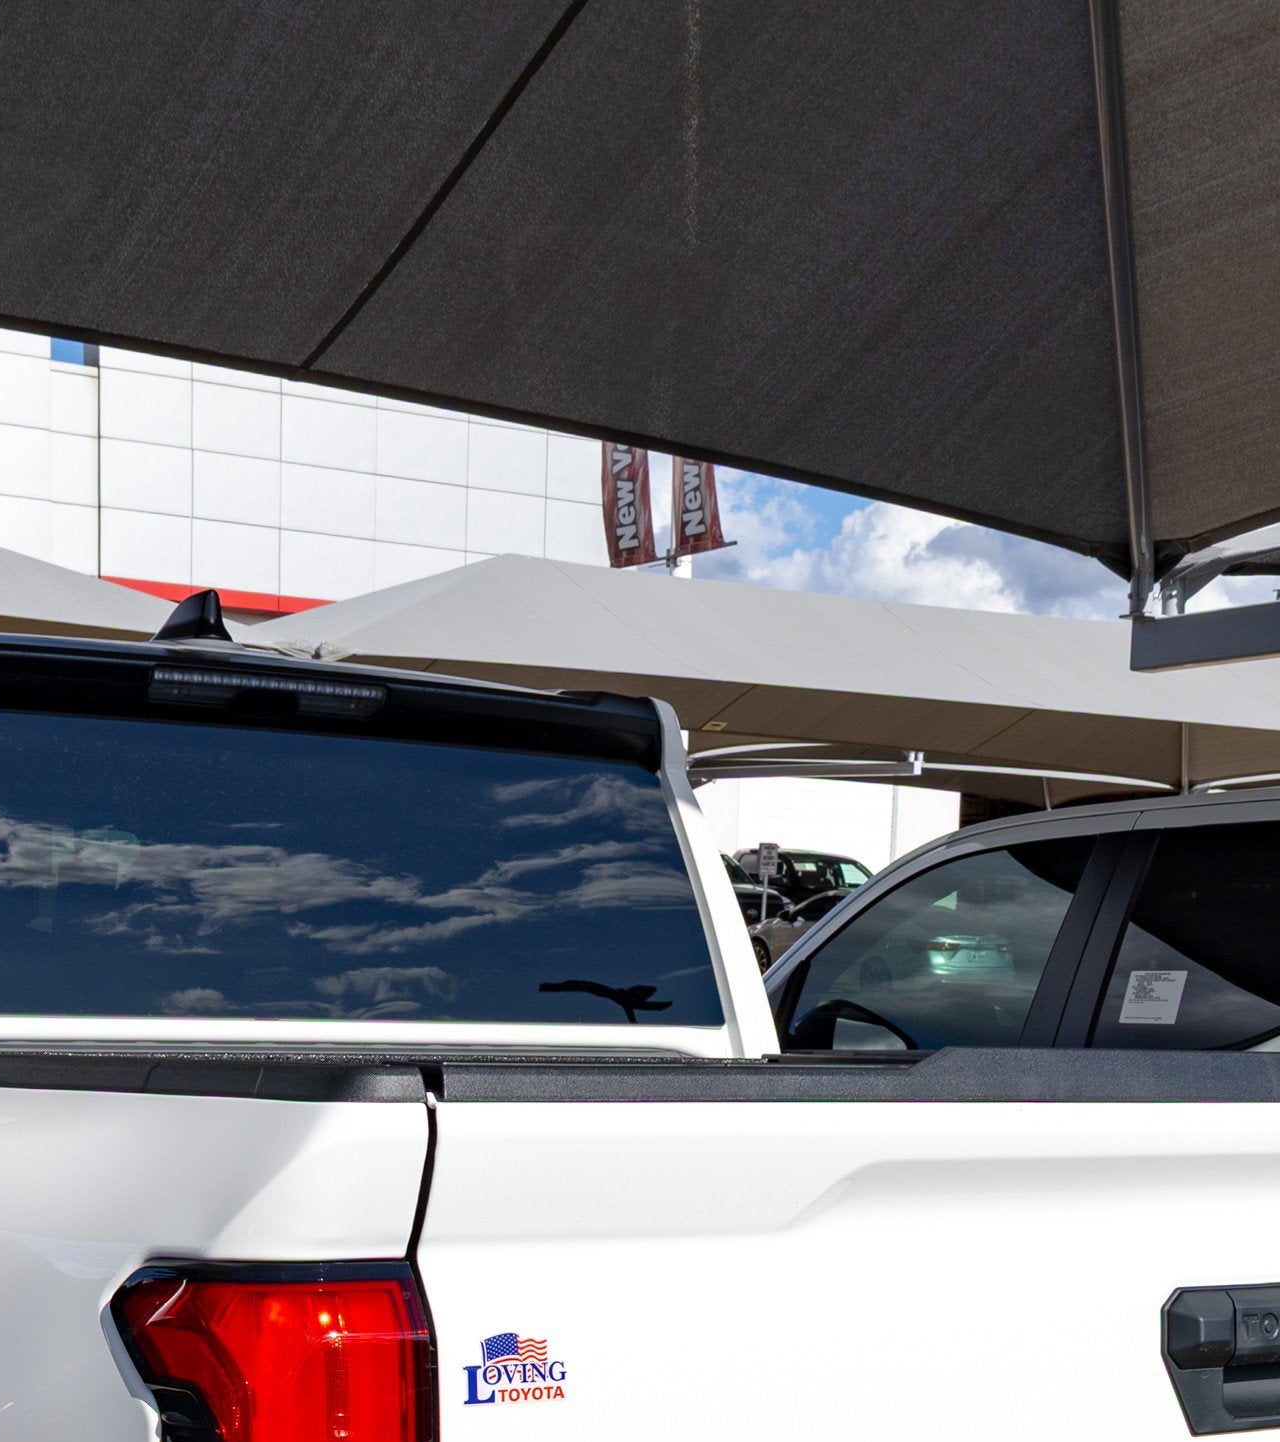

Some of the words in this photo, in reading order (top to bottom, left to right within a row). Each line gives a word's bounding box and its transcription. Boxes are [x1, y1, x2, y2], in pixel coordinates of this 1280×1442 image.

[616, 480, 639, 550] New
[682, 464, 707, 537] New
[498, 1386, 565, 1402] TOYOTA
